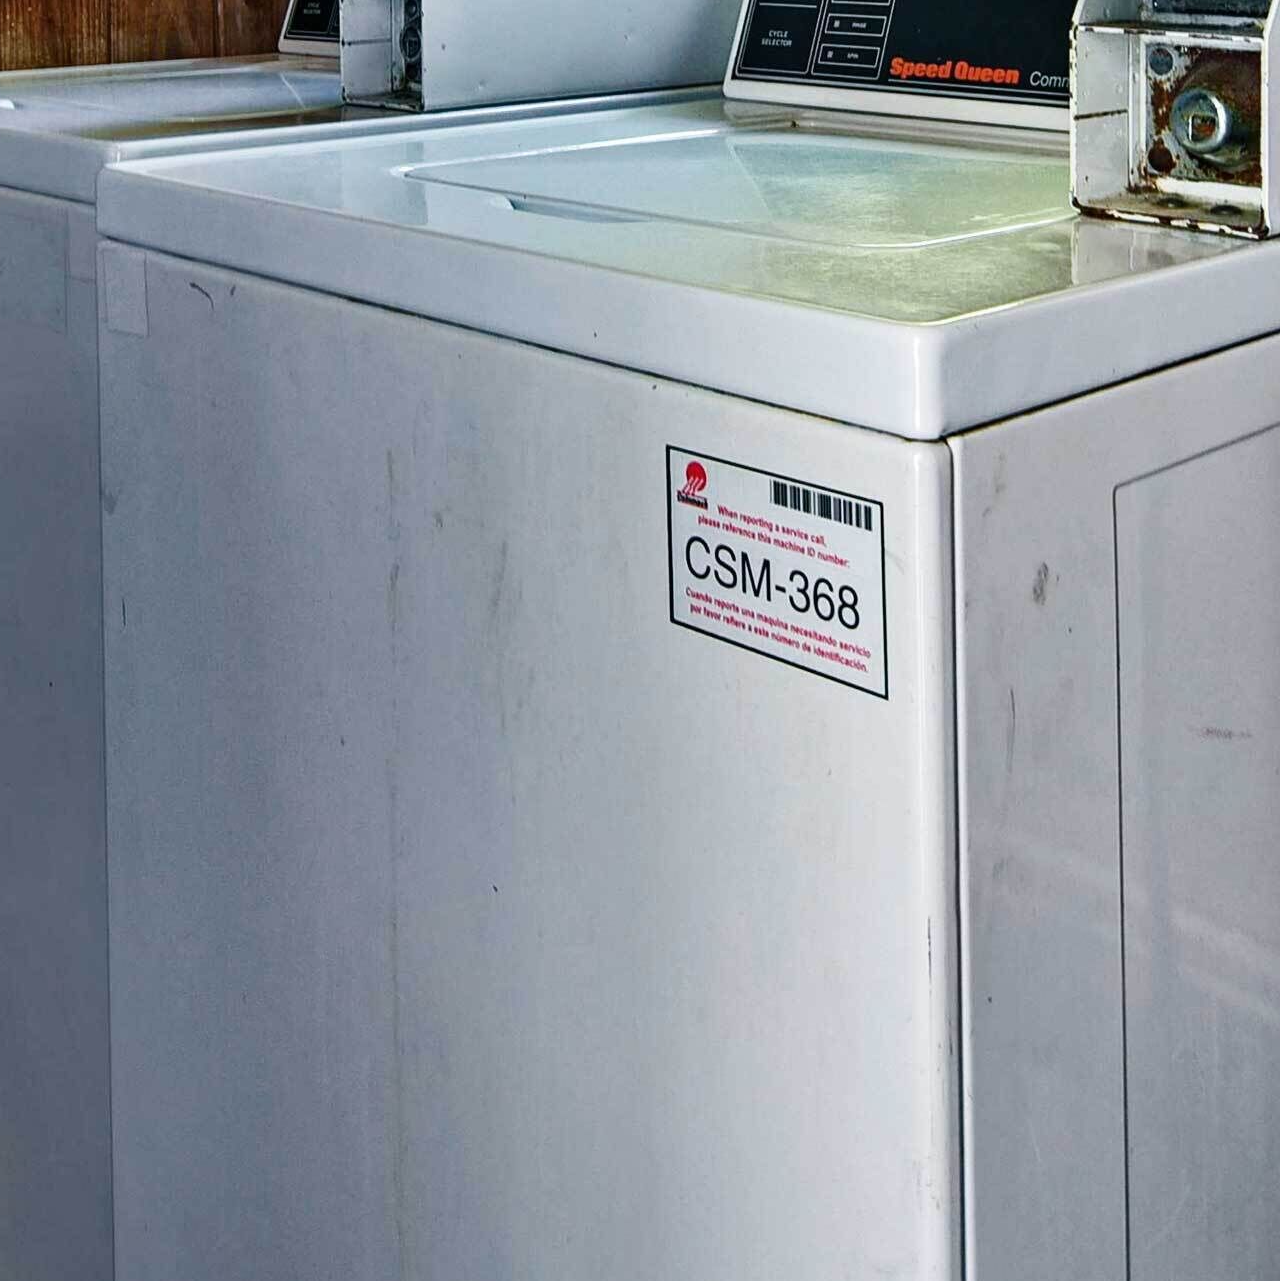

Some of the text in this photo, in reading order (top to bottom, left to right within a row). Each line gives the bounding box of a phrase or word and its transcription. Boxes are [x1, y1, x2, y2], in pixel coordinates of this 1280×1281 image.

[761, 39, 792, 47] SELECTOR
[890, 56, 1019, 84] Speed Queen
[697, 515, 720, 530] please
[722, 521, 756, 540] reference
[757, 530, 771, 543] this
[773, 537, 805, 555] machine
[806, 546, 816, 557] ID
[717, 505, 738, 519] When
[740, 513, 773, 532] reporting
[774, 523, 780, 532] a
[781, 525, 808, 541] service
[685, 535, 860, 630] CSM-368
[685, 586, 871, 659] Cuando reporte una maquina necesitando servicio
[689, 603, 702, 615] por
[703, 606, 722, 621] favor
[722, 614, 746, 630] refiere
[754, 625, 770, 639] este
[771, 633, 800, 649] número
[802, 642, 812, 653] de
[813, 647, 869, 672] identificación.
